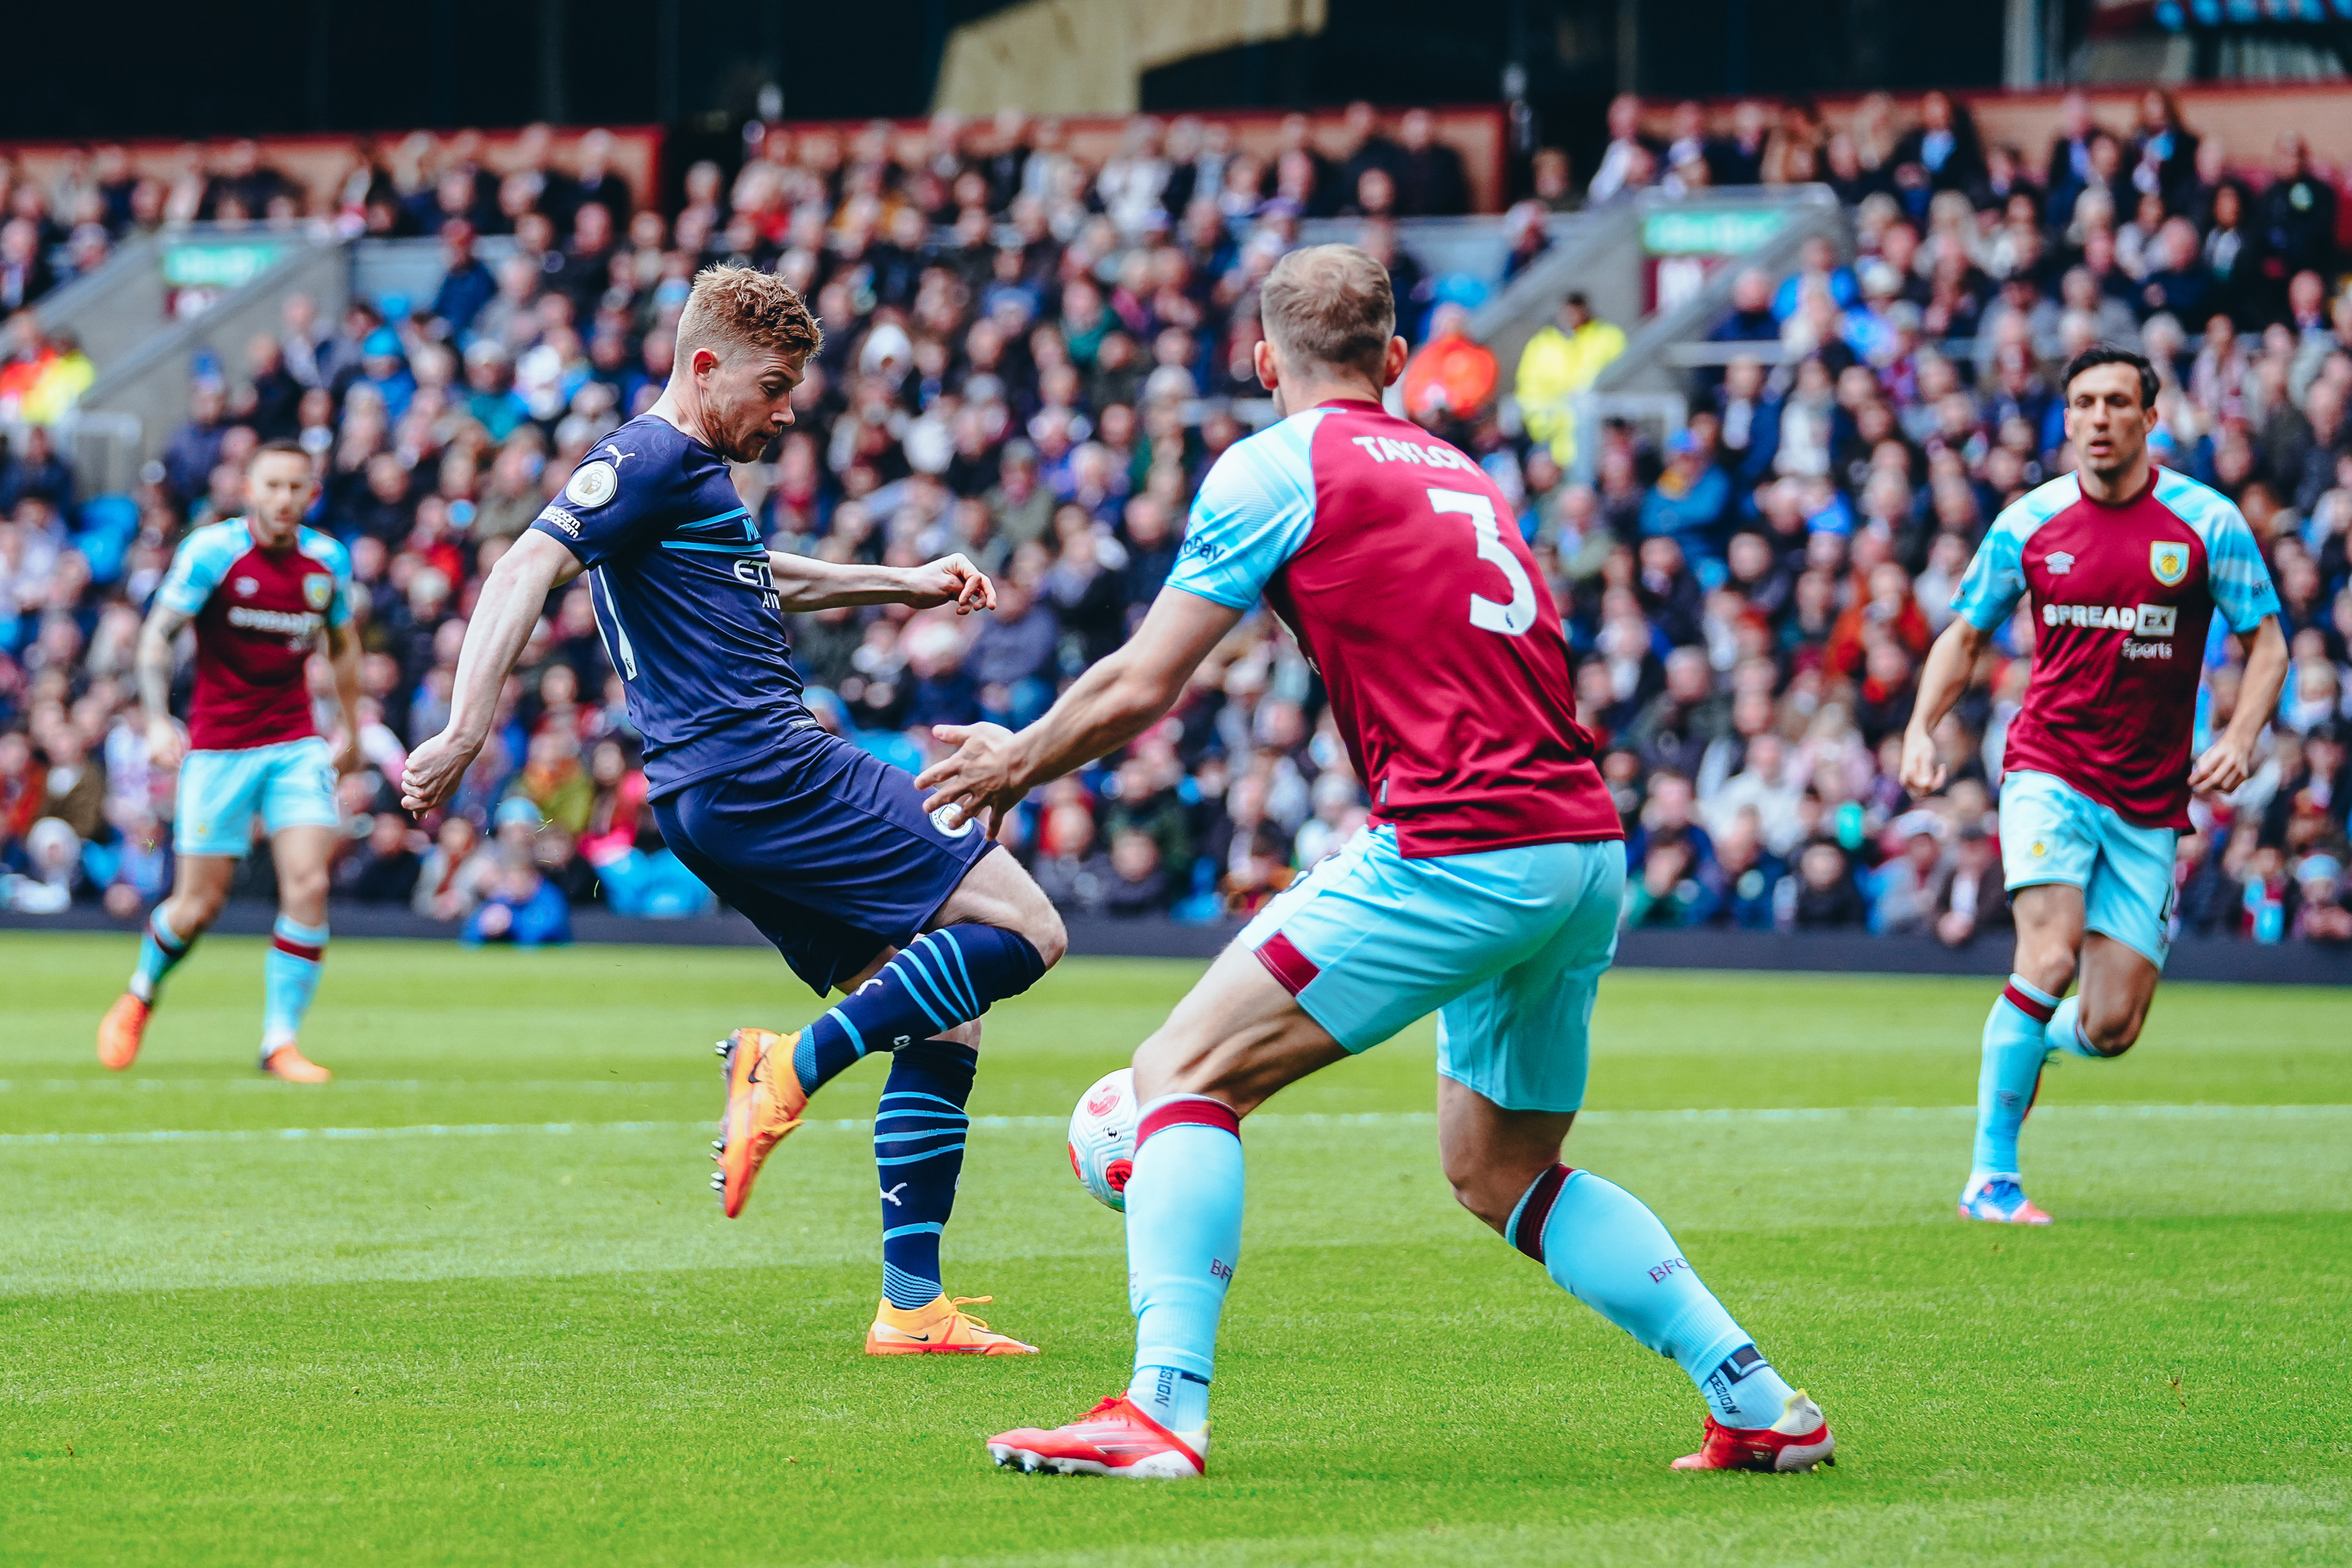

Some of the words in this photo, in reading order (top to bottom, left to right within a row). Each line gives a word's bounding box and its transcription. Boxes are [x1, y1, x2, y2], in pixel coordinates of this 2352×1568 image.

[1426, 487, 1537, 636] 3
[2121, 638, 2172, 662] Sports
[1647, 1258, 1690, 1283] BFC
